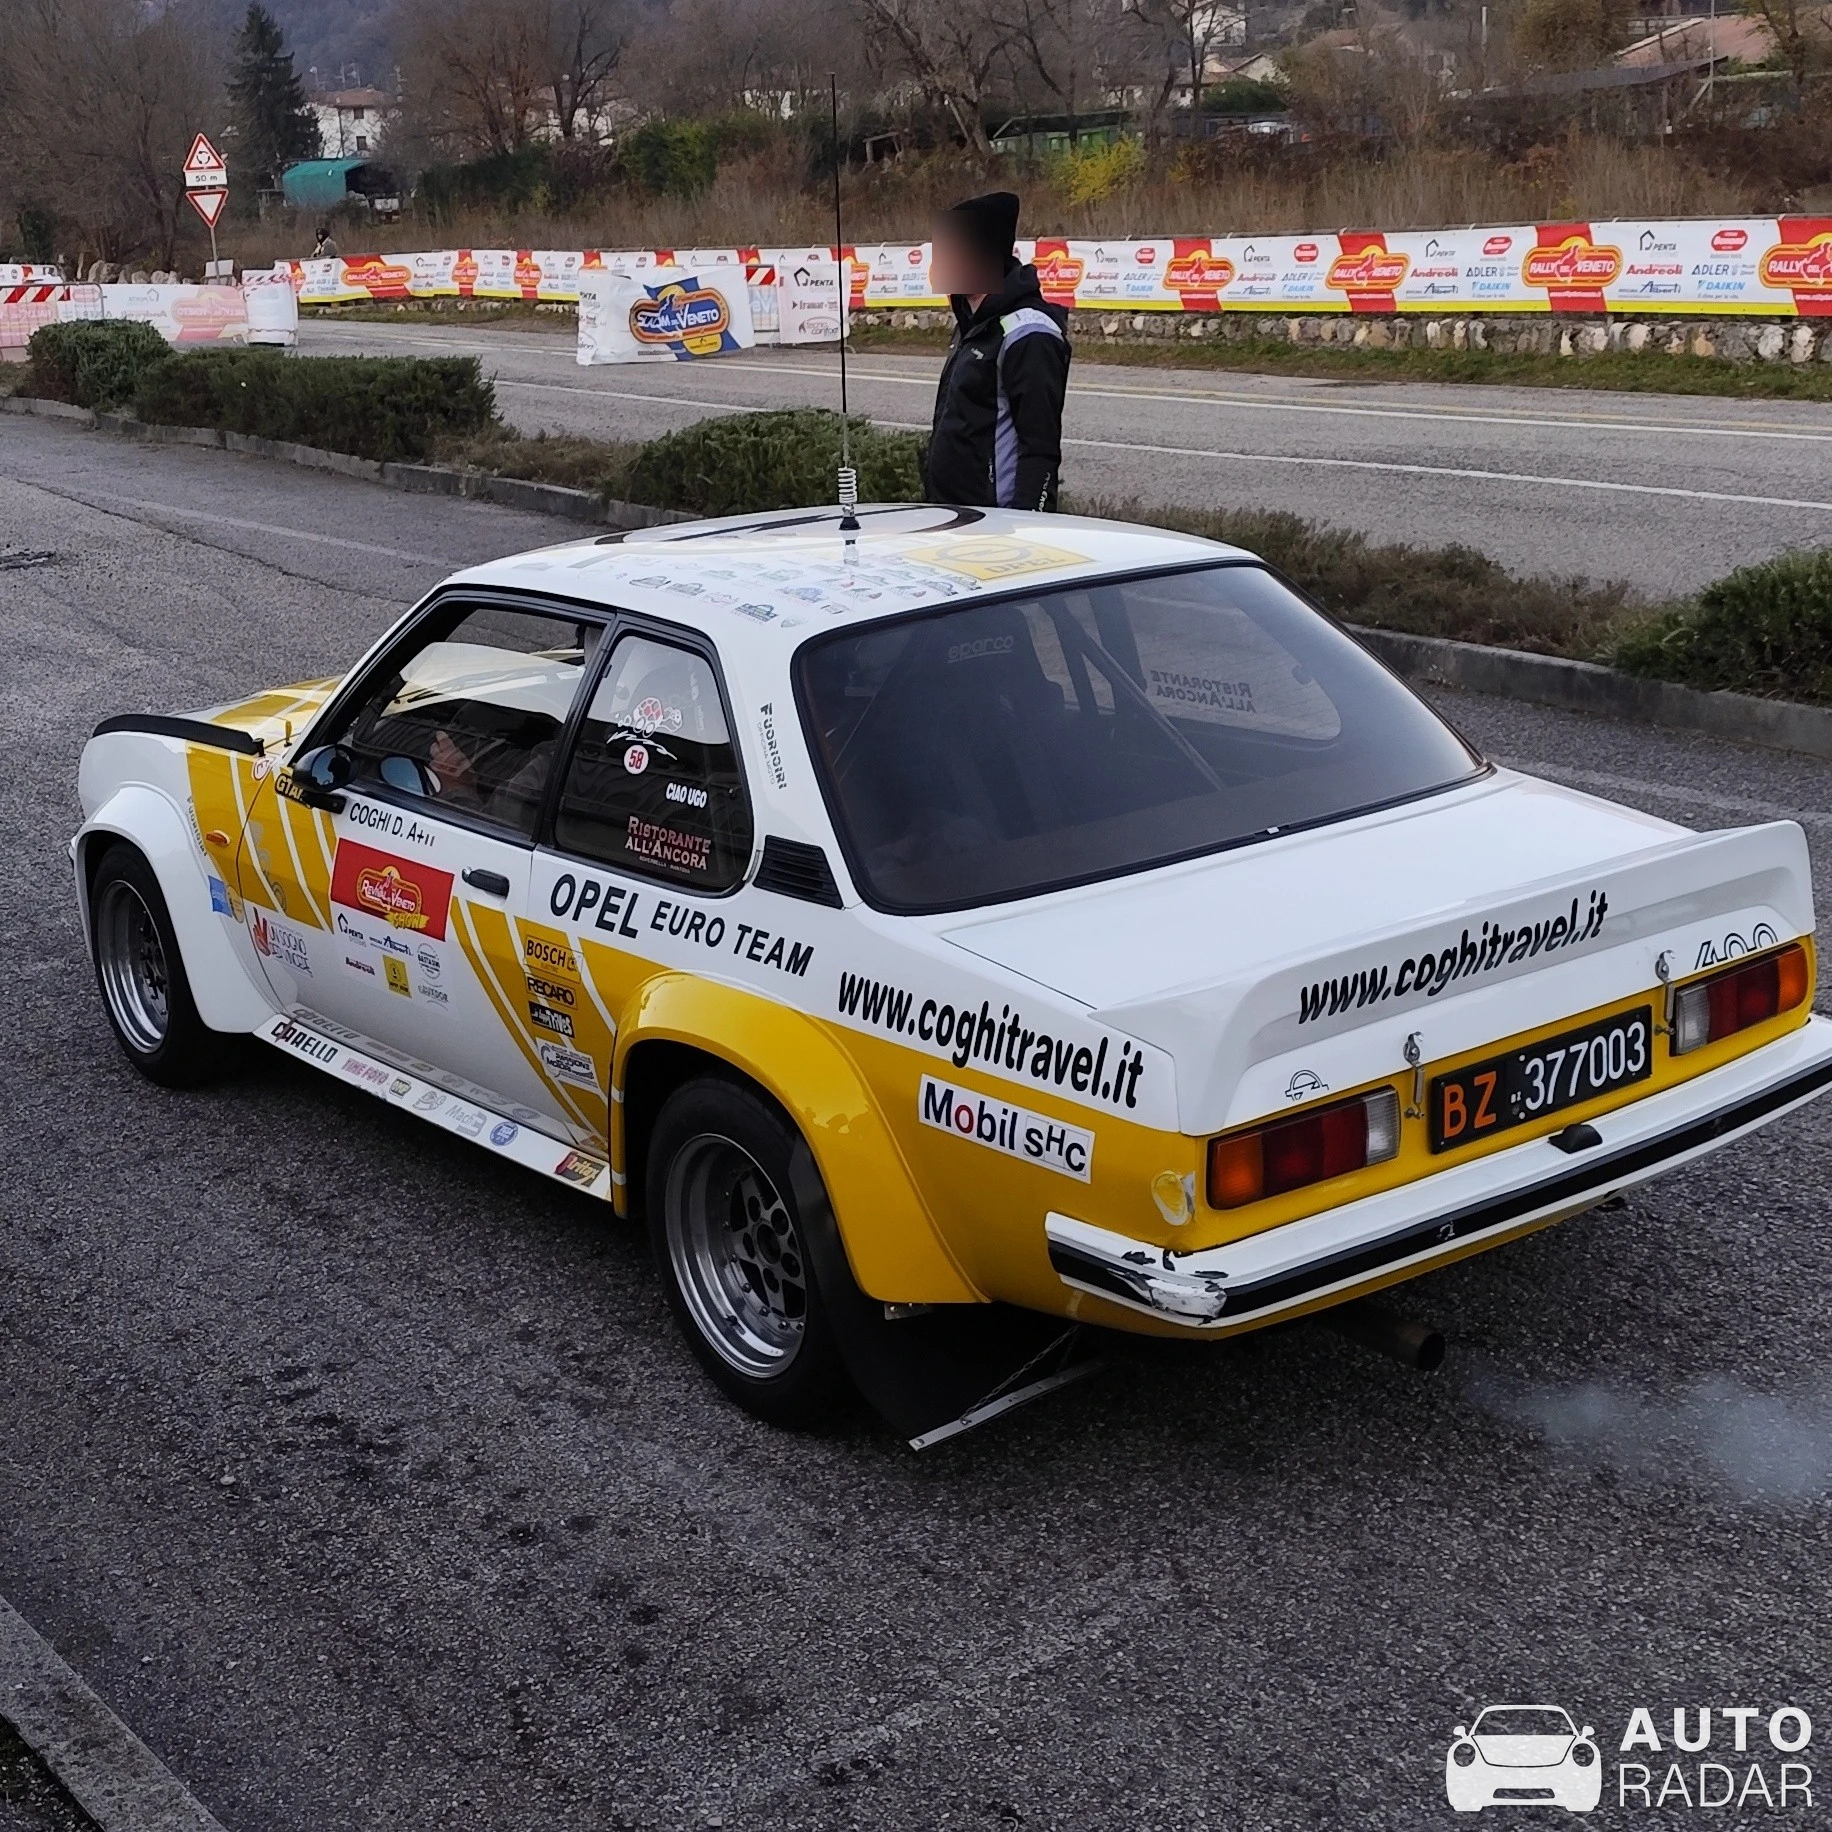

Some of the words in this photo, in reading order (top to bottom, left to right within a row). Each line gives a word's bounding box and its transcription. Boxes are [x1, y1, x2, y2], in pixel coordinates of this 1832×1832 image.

[195, 175, 207, 183] 50
[1653, 243, 1677, 251] PENTA
[1410, 267, 1459, 278] Andreoli
[1466, 267, 1498, 278] ADLER
[1529, 261, 1557, 275] RALLY
[1576, 260, 1616, 273] VENETO
[1626, 264, 1684, 275] Andreoli
[1692, 264, 1730, 276] ADLER
[1768, 260, 1802, 273] RALLY
[810, 279, 834, 287] PENTA
[1705, 281, 1746, 291] DAIKIN
[676, 303, 720, 329] VENETO
[628, 749, 643, 770] 58
[665, 782, 688, 803] CIAO
[687, 787, 708, 809] UGO
[349, 802, 392, 832] COGHI
[392, 815, 404, 838] D.
[627, 815, 712, 854] RISTORANTE
[624, 835, 708, 871] ALL'ANCORA
[391, 888, 416, 912] VENETO
[348, 928, 364, 940] PENTA
[550, 873, 640, 939] OPEL
[650, 900, 726, 948] EURO
[733, 923, 815, 977] TEAM
[526, 939, 567, 968] BOSCH
[1298, 890, 1609, 1024] www.coghitravel.it
[527, 976, 575, 1006] RECARO
[270, 1021, 339, 1064] CARELLO
[838, 971, 1144, 1109] www.coghitravel.it
[1443, 1071, 1498, 1138] BZ
[1525, 1021, 1646, 1111] 377003
[924, 1082, 1019, 1151] Mobil
